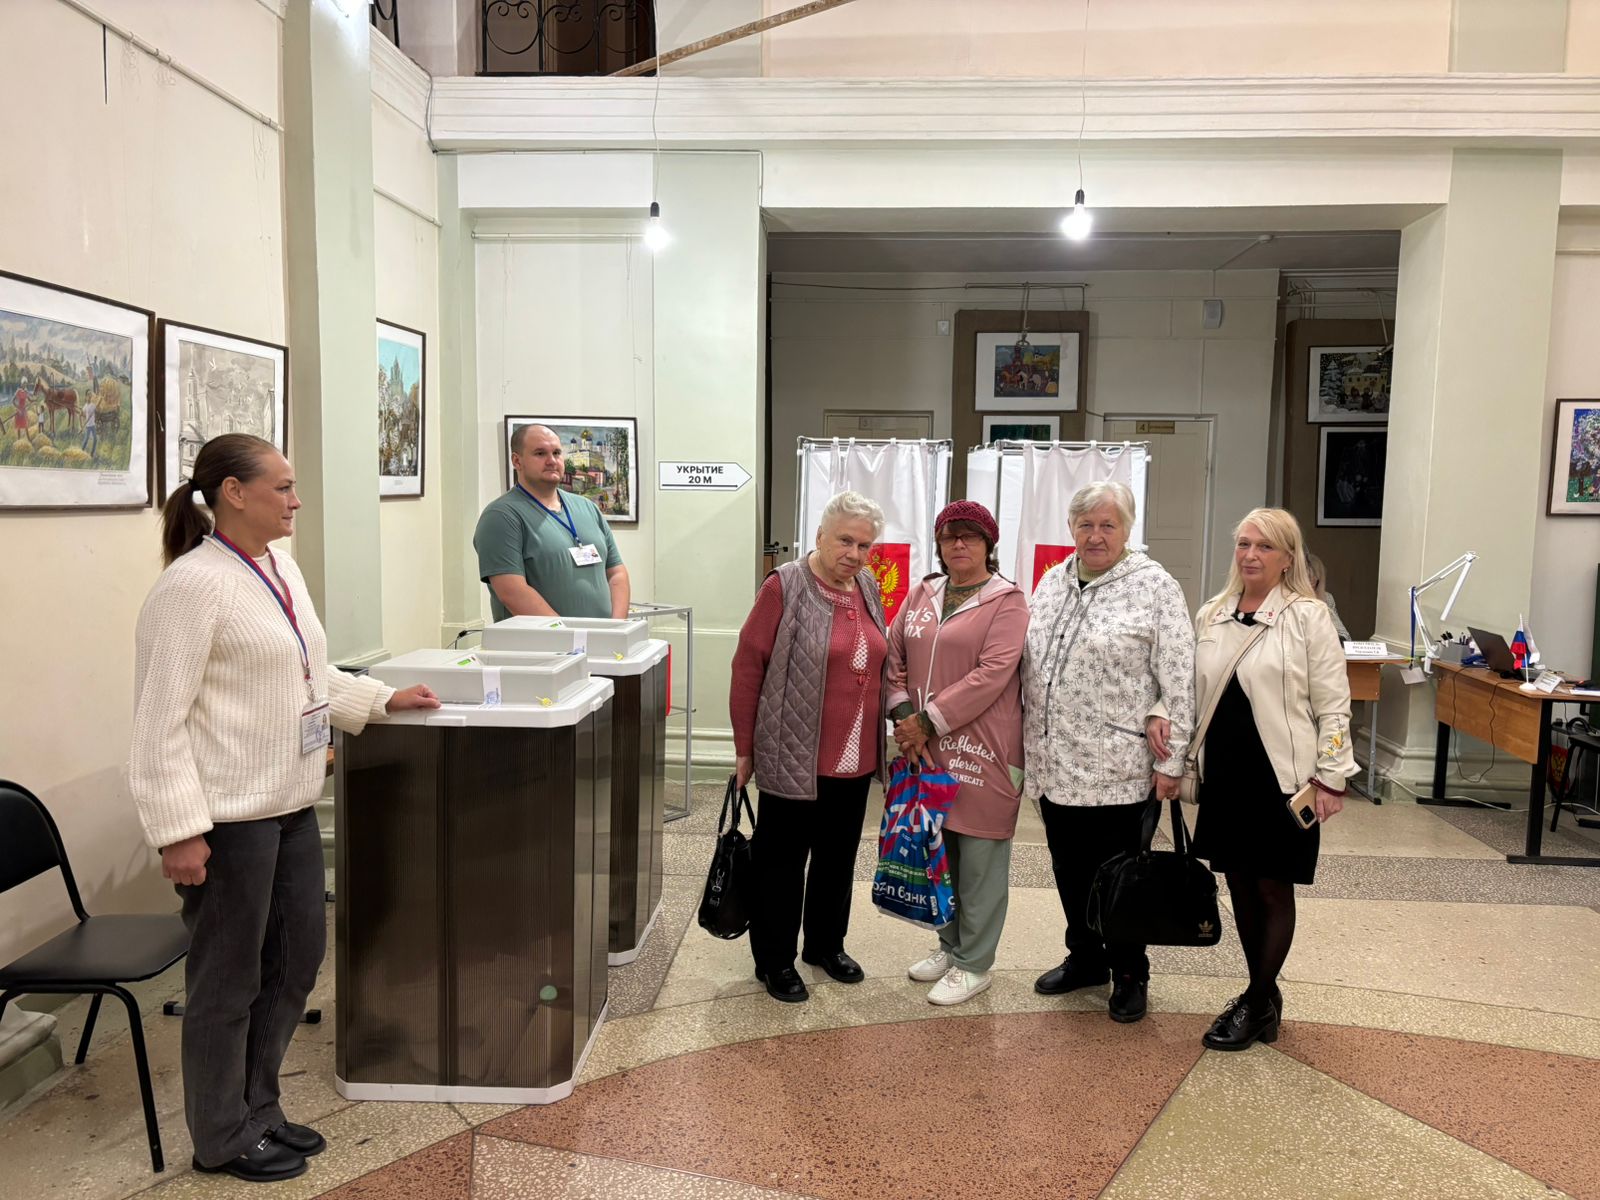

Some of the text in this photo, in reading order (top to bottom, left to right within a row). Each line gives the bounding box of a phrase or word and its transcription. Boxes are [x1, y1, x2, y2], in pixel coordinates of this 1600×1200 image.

[676, 465, 724, 474] УКРЫТИЕ
[688, 475, 701, 484] 20
[939, 734, 996, 763] Reflected
[897, 885, 928, 905] банк
